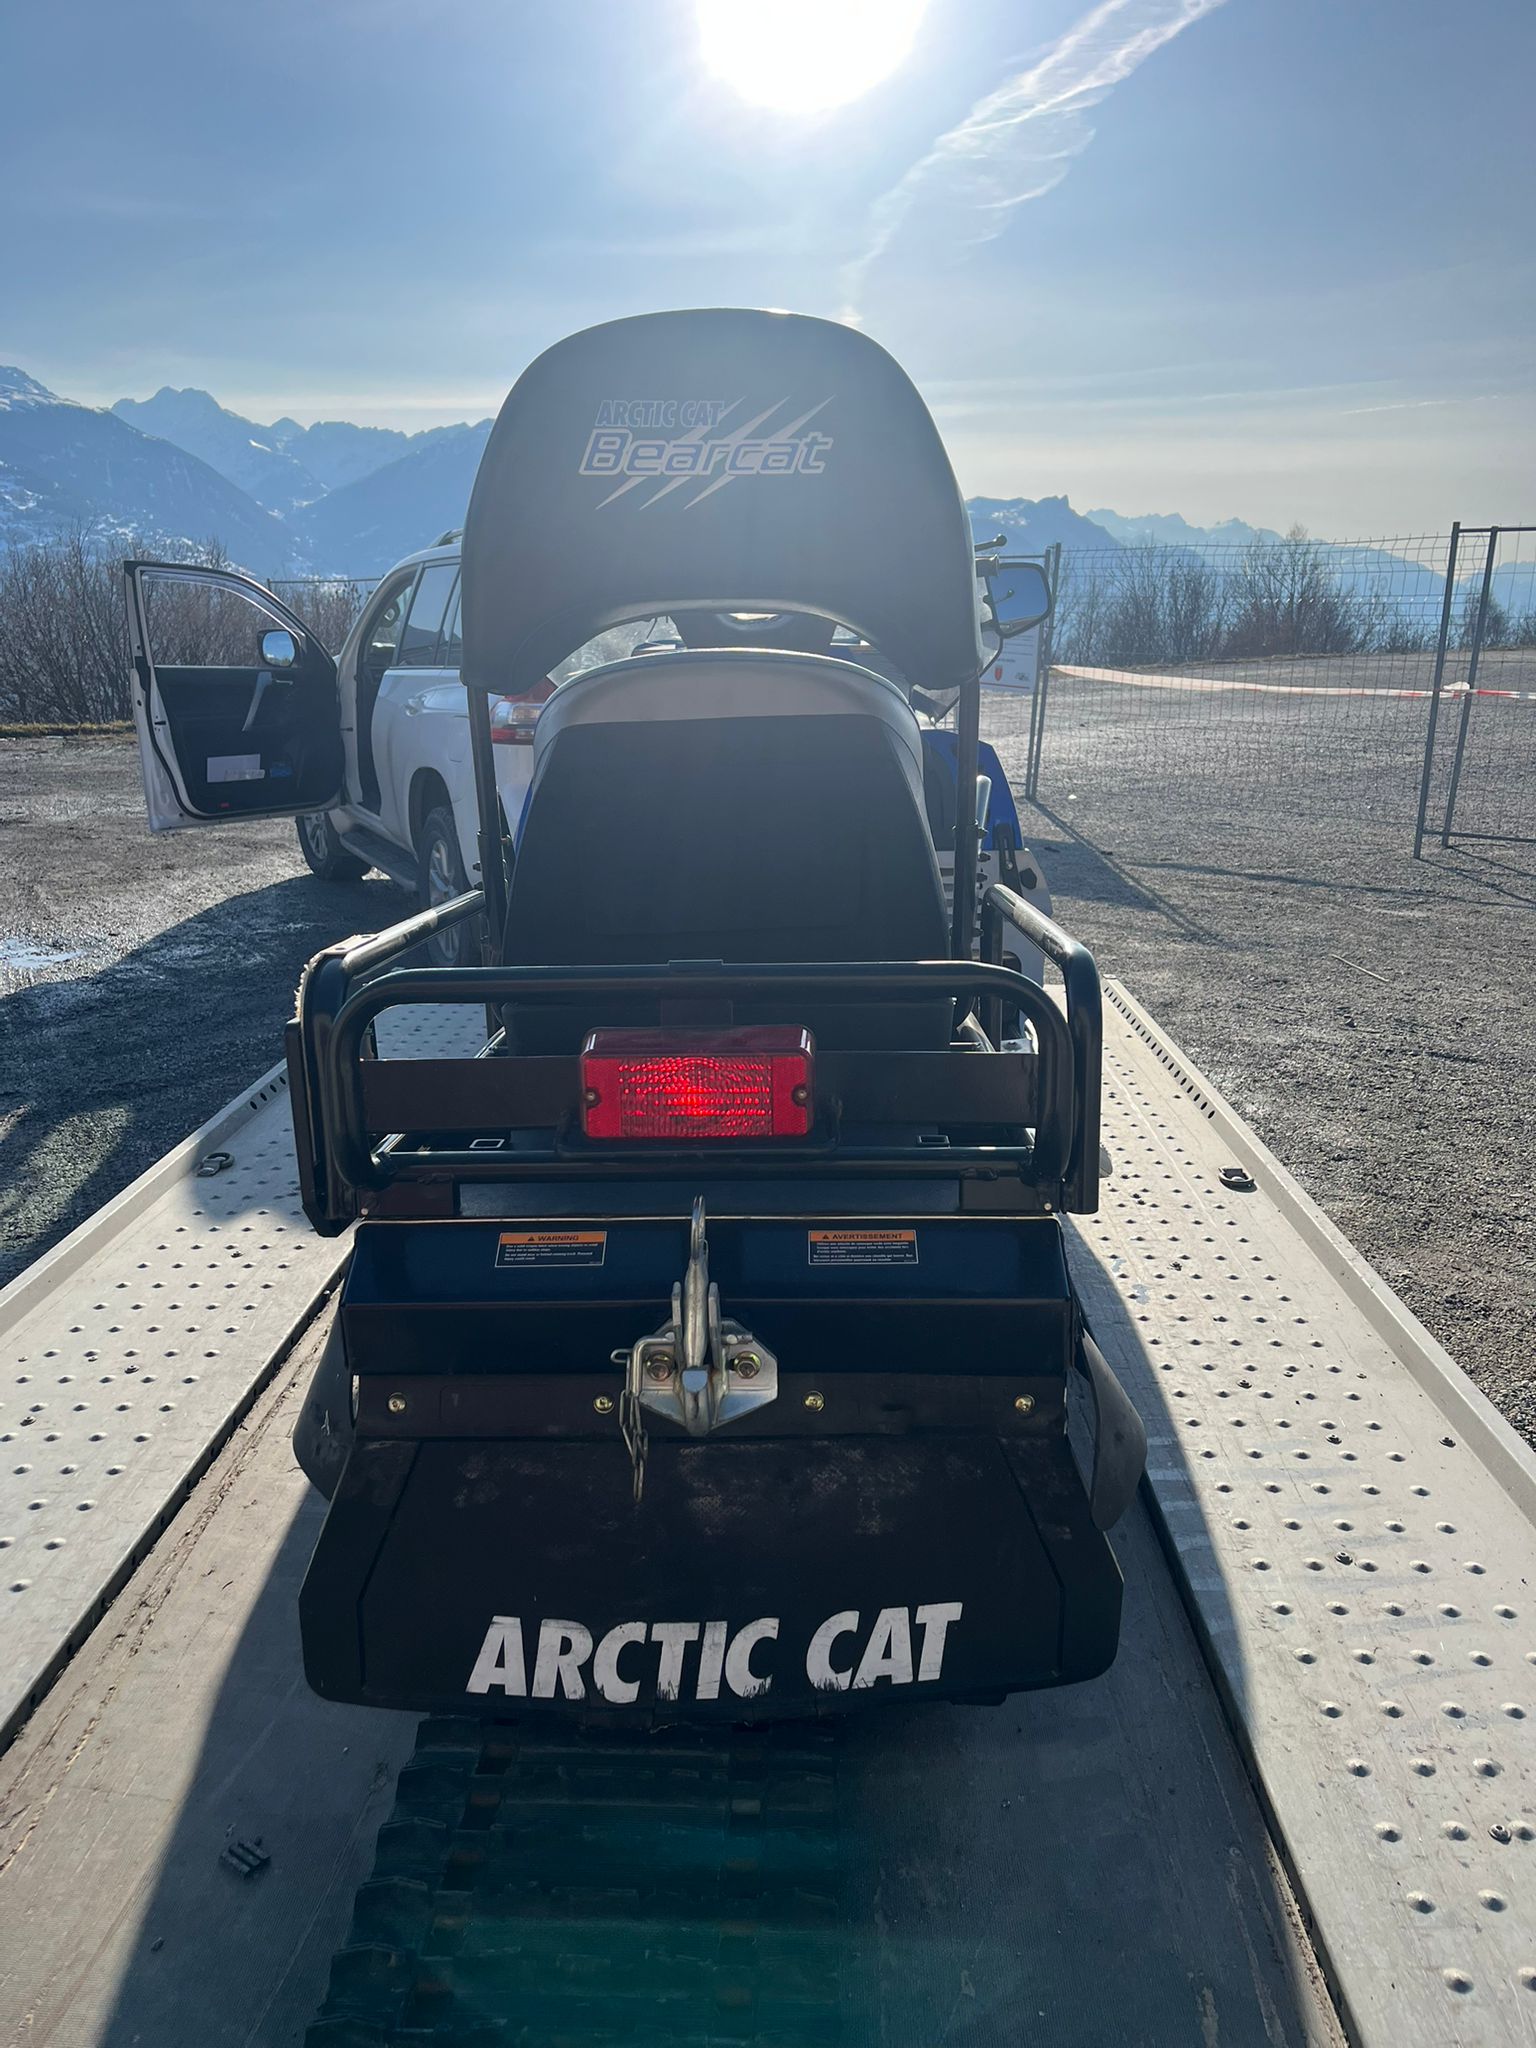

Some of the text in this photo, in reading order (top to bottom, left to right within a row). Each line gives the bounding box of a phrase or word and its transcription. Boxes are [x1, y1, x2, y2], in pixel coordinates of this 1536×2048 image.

[595, 400, 725, 428] ARCTIC CAT
[578, 427, 834, 476] Bearcat
[537, 1234, 580, 1242] WARNING
[465, 1602, 963, 1704] ARCTIC CAT
